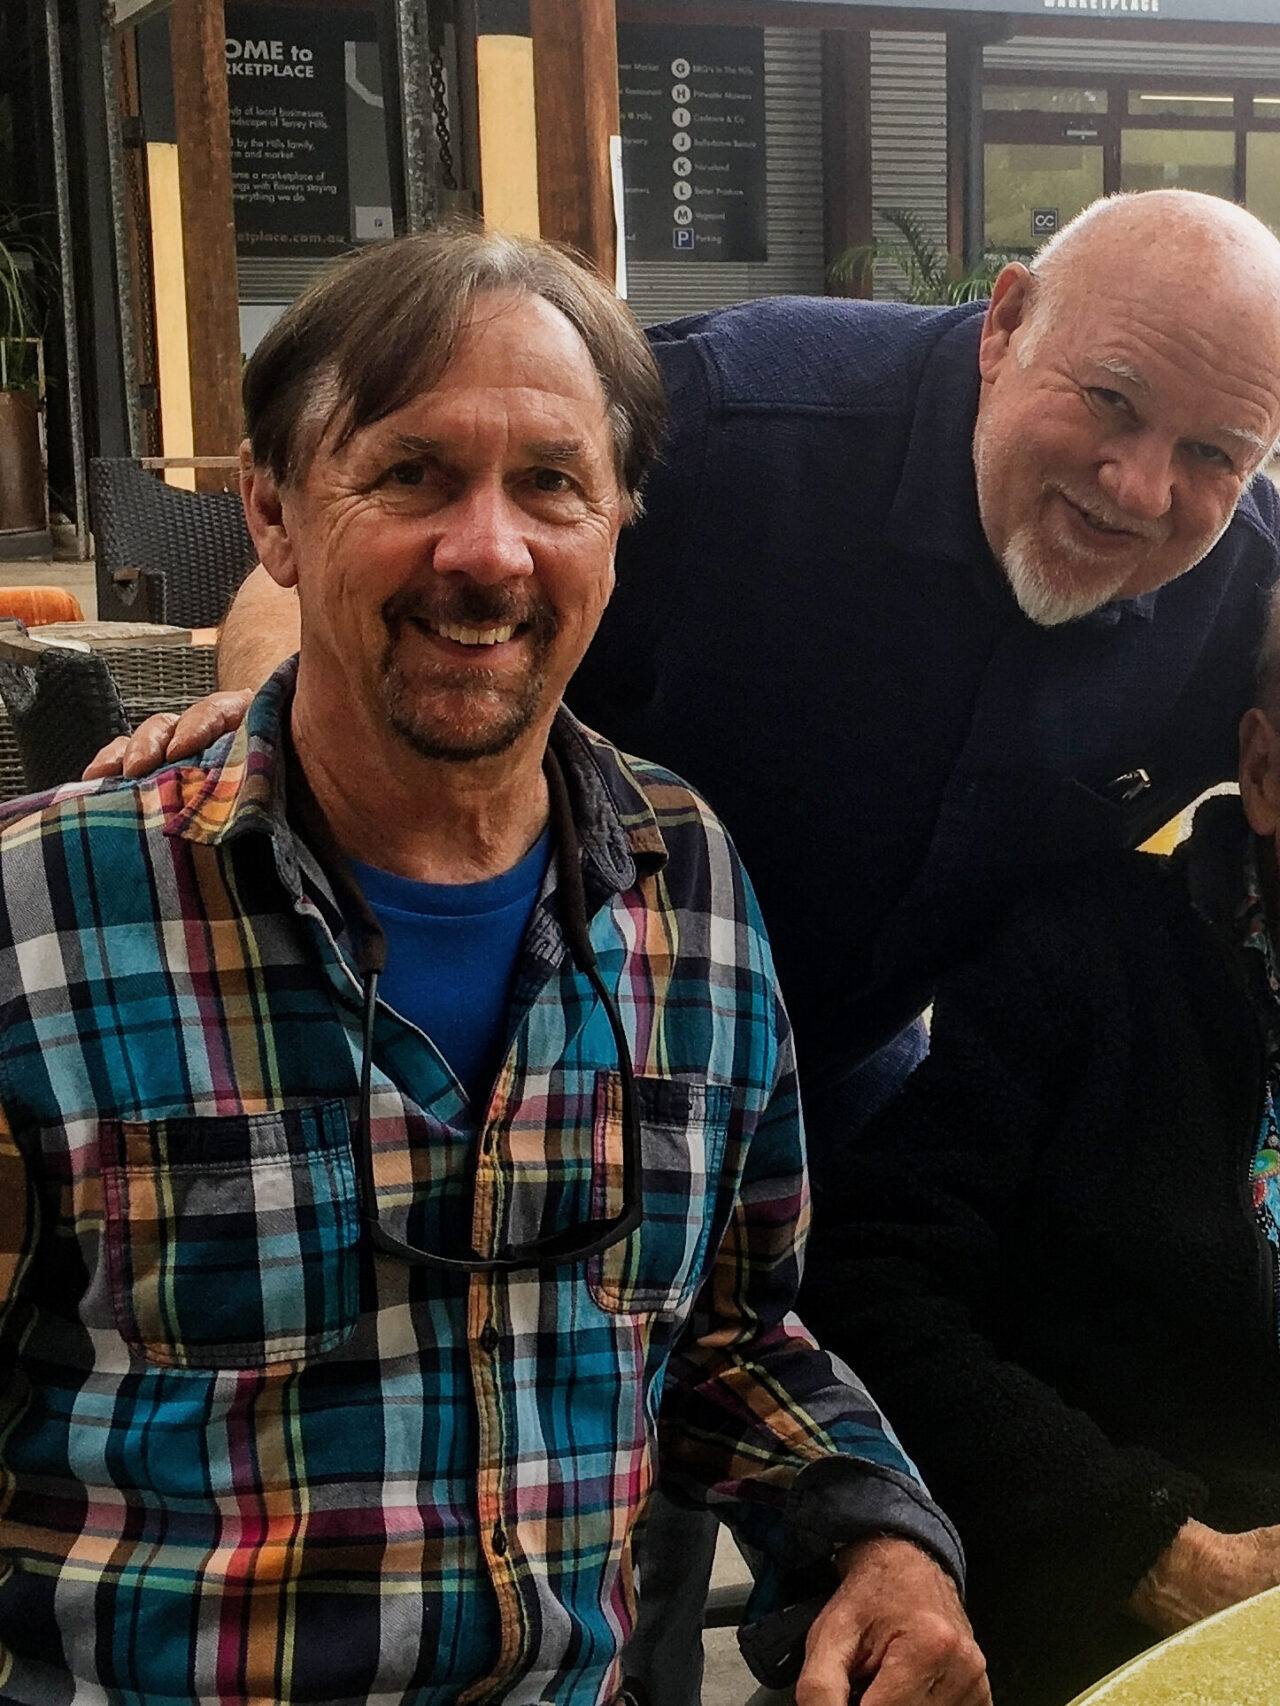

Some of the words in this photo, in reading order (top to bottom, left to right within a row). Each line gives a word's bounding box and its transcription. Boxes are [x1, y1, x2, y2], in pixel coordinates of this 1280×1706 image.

[290, 45, 313, 61] to
[675, 62, 686, 74] G
[676, 88, 686, 99] H
[677, 161, 686, 172] K
[677, 210, 688, 220] M
[678, 230, 689, 246] P
